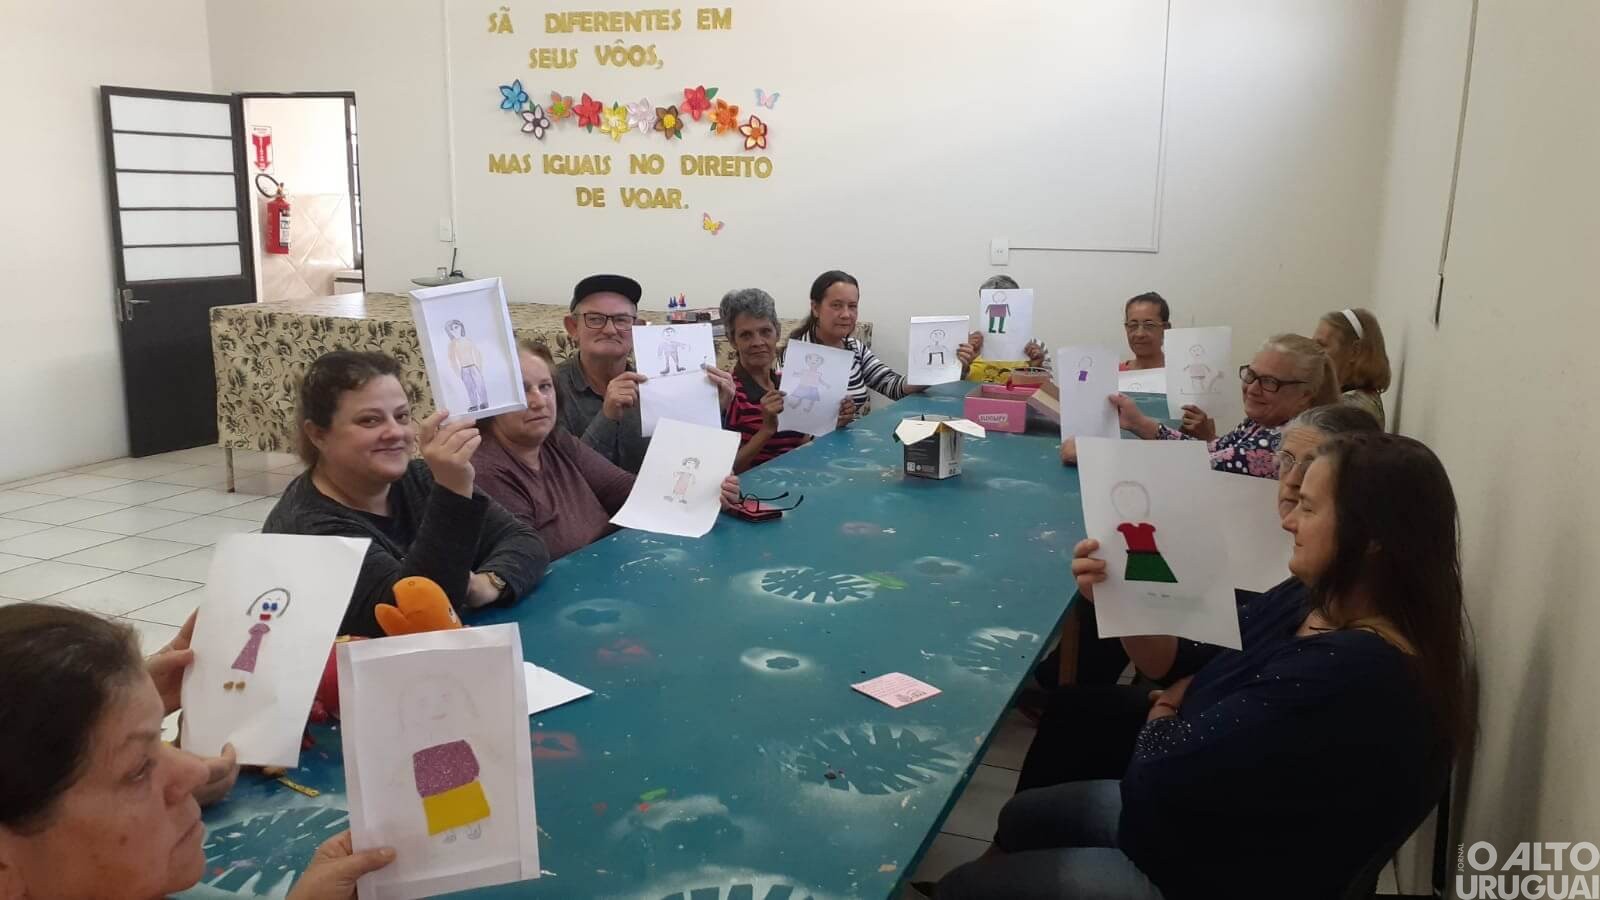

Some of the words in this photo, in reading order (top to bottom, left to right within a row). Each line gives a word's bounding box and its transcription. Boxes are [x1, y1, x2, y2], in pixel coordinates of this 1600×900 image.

[488, 6, 514, 34] SÃ
[544, 9, 682, 34] DIFERENTES
[696, 7, 733, 31] EM
[528, 48, 577, 69] SEUS
[594, 39, 664, 69] VÔOS,
[488, 154, 532, 175] MAS
[543, 154, 612, 176] IGUAIS
[629, 154, 665, 176] NO
[680, 154, 773, 179] DIREITO
[575, 186, 606, 208] DE
[619, 187, 689, 210] VOAR.
